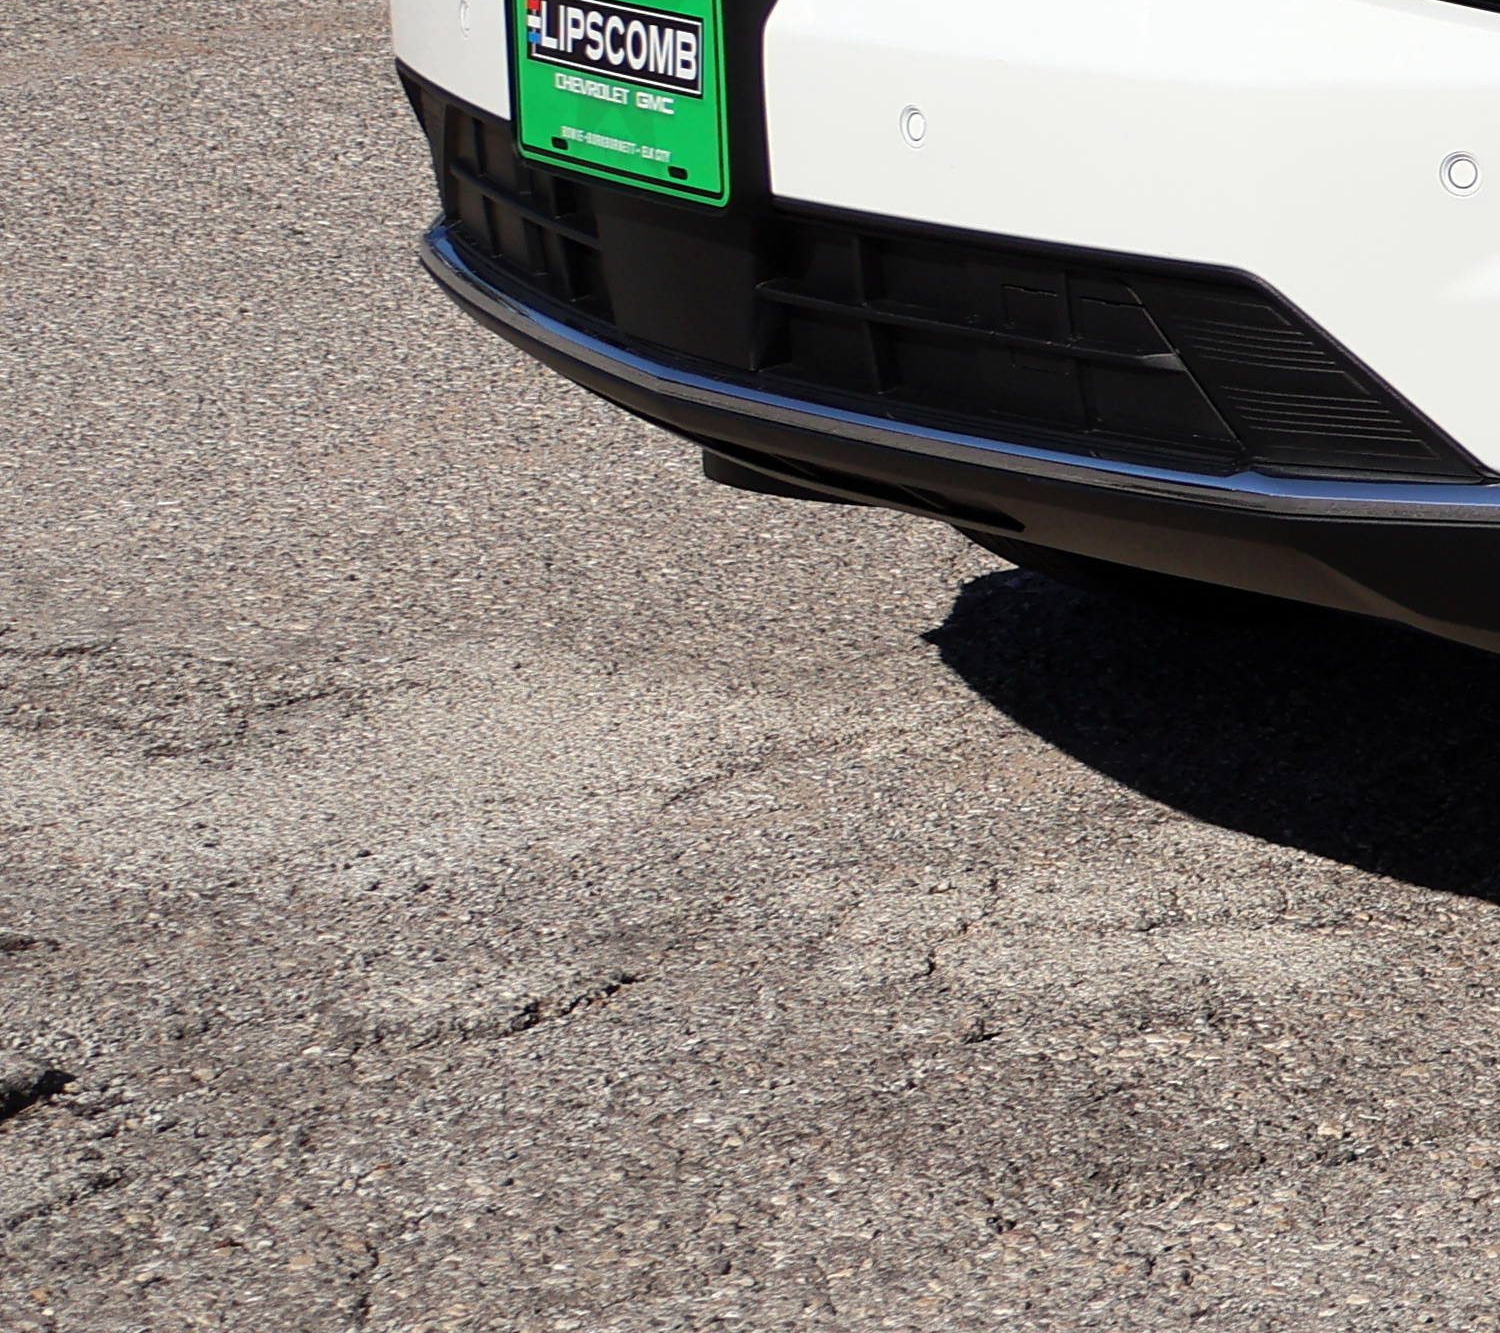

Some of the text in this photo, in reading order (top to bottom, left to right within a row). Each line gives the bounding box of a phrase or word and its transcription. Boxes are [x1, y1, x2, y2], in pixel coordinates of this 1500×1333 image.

[540, 0, 698, 81] LIPSCOMB
[554, 72, 675, 115] CHEVROLET GMC
